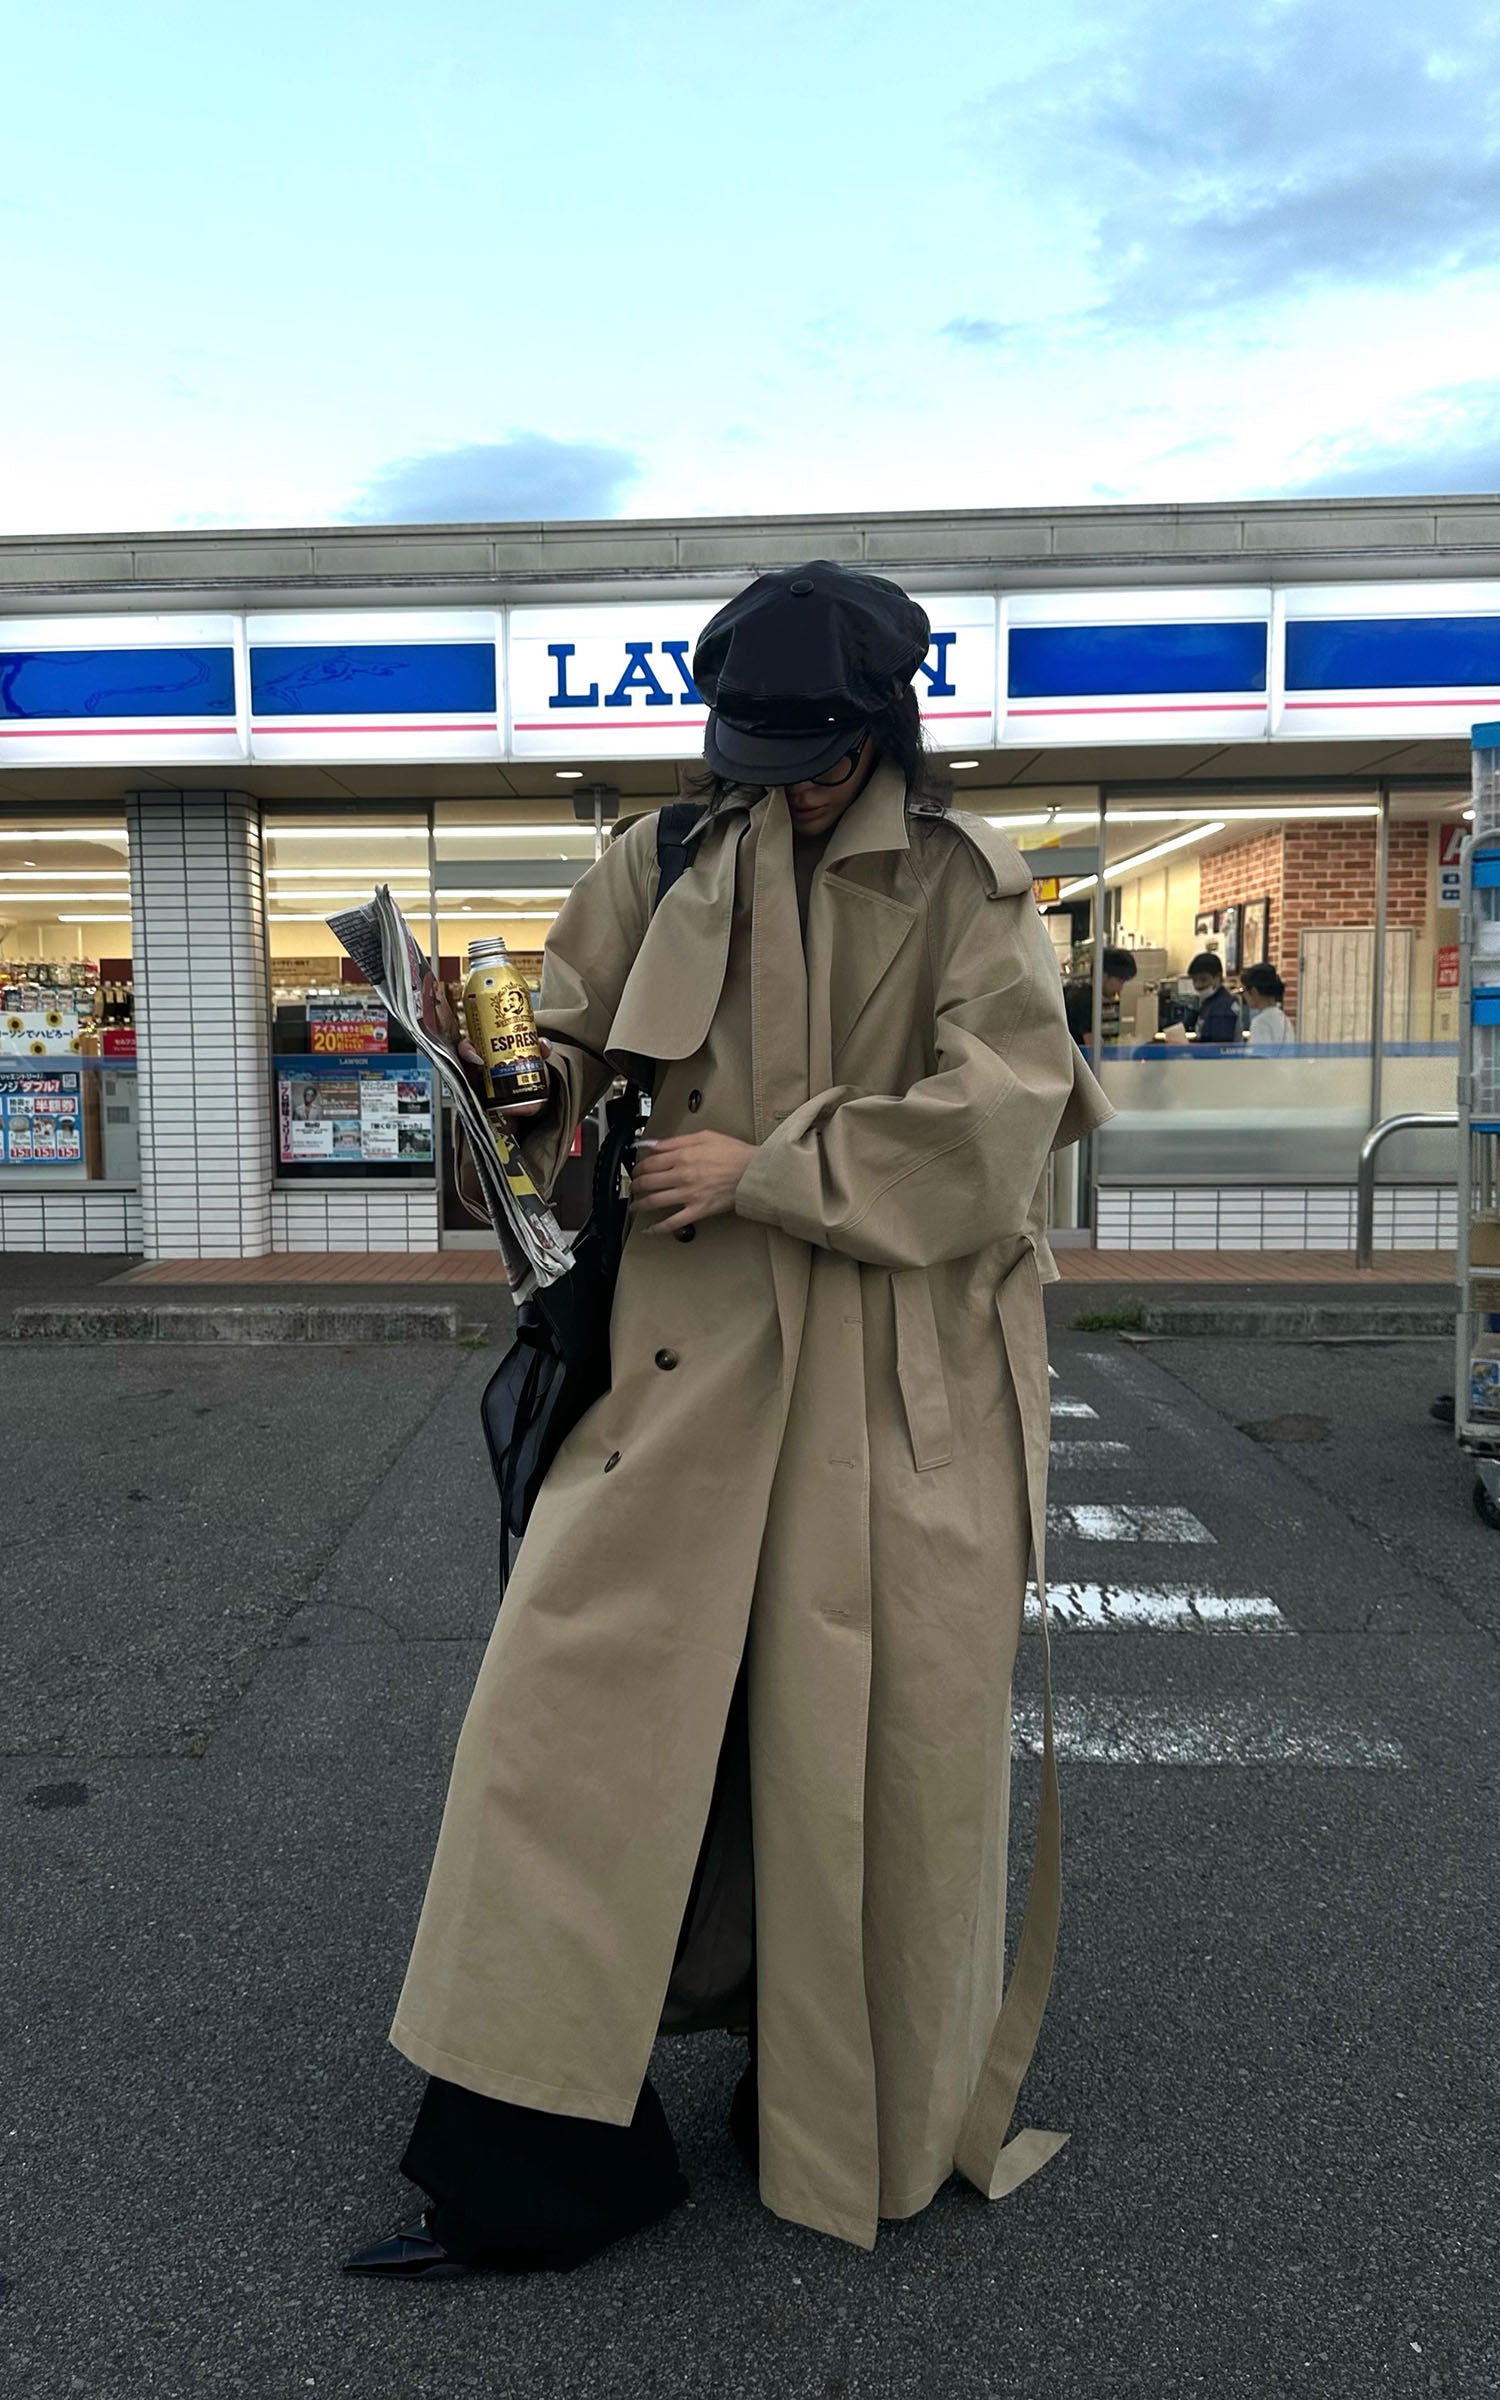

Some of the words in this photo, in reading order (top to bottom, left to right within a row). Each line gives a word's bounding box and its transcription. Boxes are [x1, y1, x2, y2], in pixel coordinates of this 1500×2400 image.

[0, 1029, 74, 1039] ーソンでハピろー!
